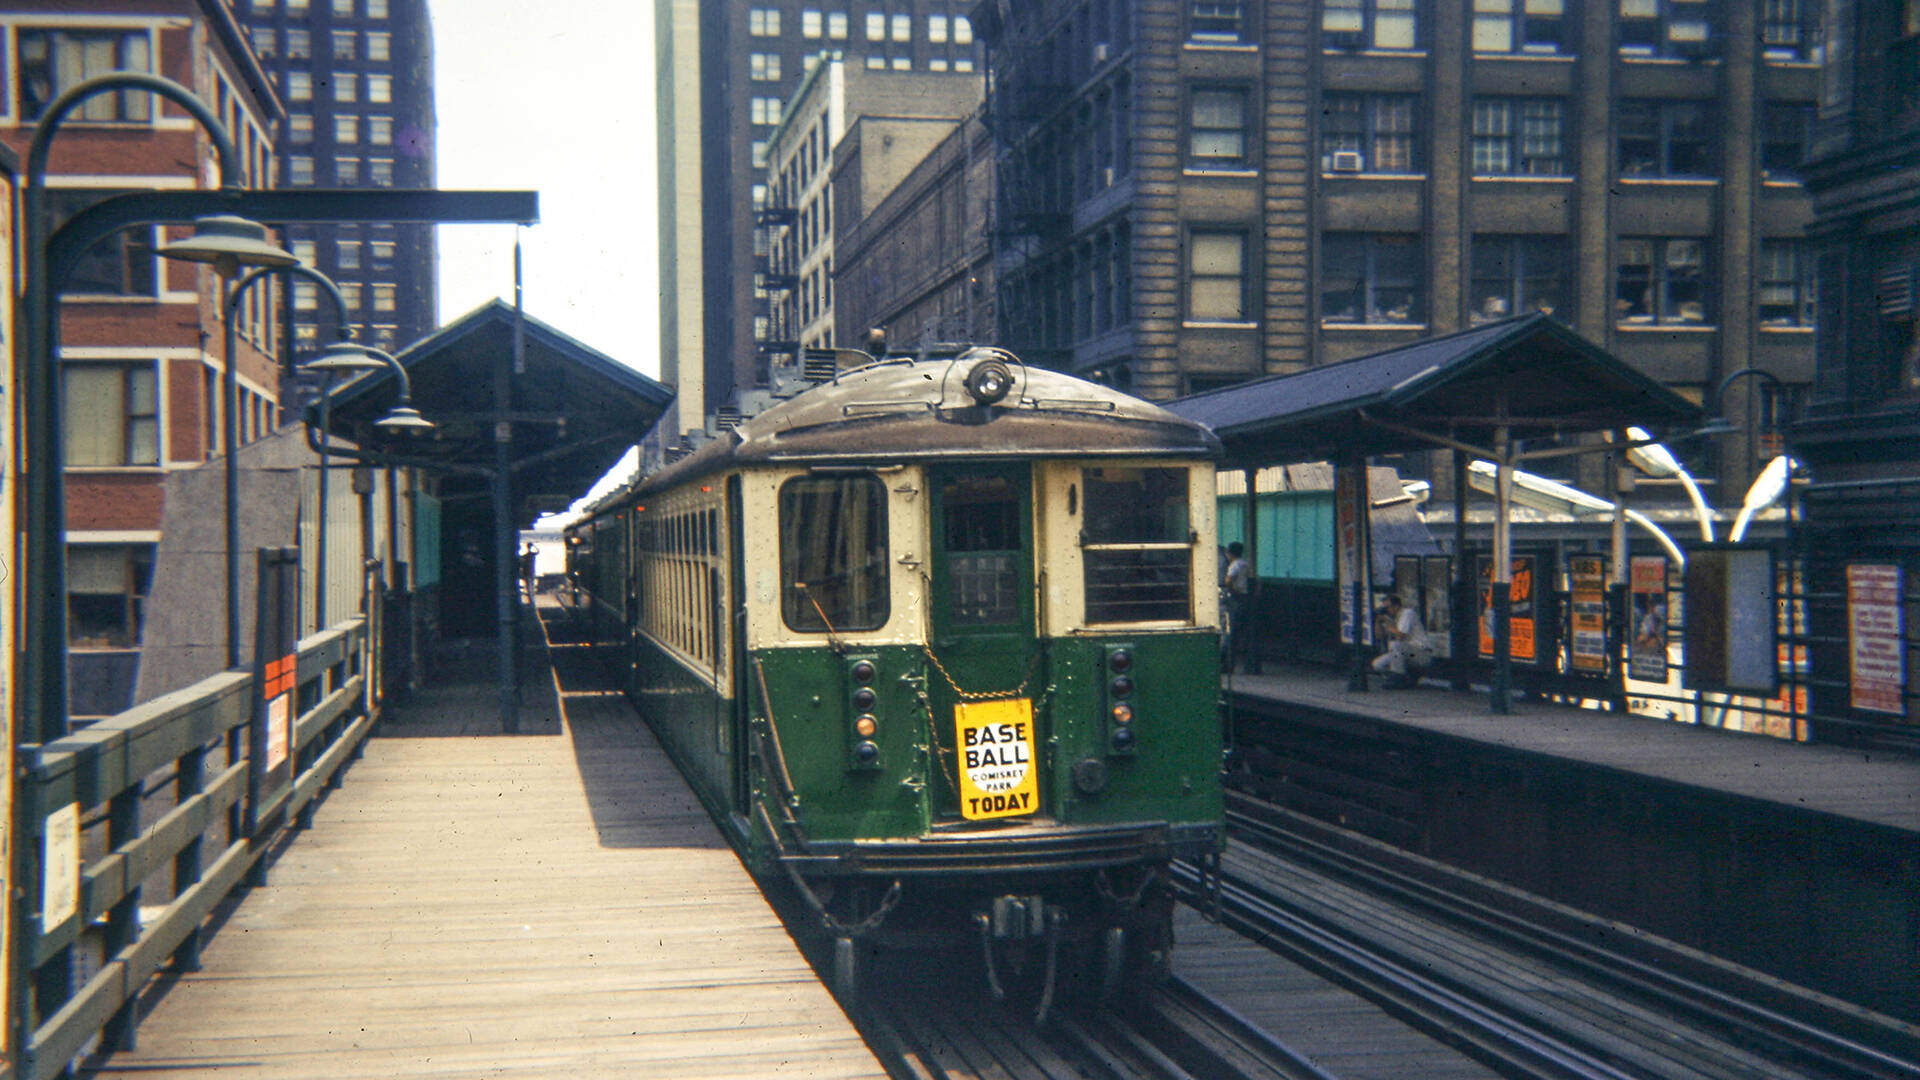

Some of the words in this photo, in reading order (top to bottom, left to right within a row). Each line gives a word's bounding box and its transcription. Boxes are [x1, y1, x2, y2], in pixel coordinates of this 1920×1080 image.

[964, 723, 1027, 747] BASE
[965, 746, 1029, 769] BALL
[972, 770, 1024, 782] COMISKEY
[986, 782, 1013, 792] PARK
[969, 792, 1030, 814] TODAY
